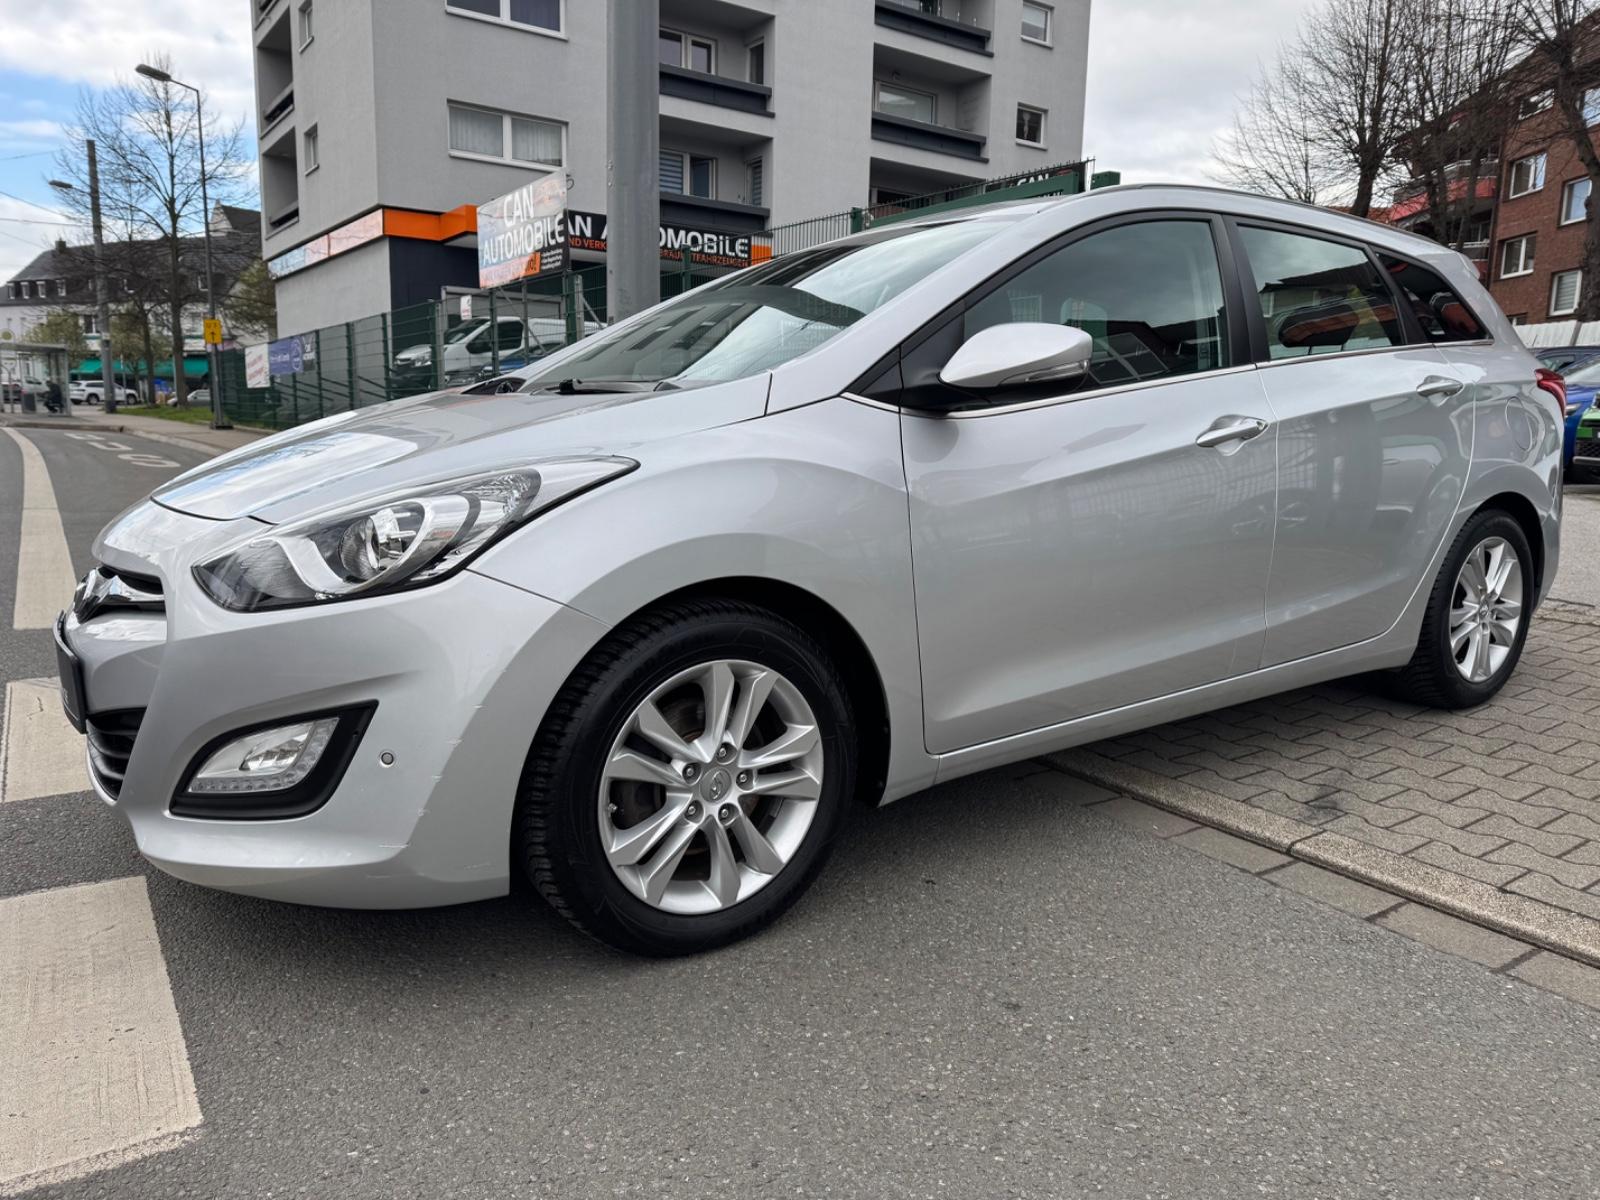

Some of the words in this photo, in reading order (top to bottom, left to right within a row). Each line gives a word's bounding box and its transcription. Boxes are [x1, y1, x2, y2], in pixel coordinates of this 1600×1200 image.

[503, 184, 535, 228] CAN
[483, 212, 566, 265] AUTOMOBILE
[583, 238, 608, 250] VERK
